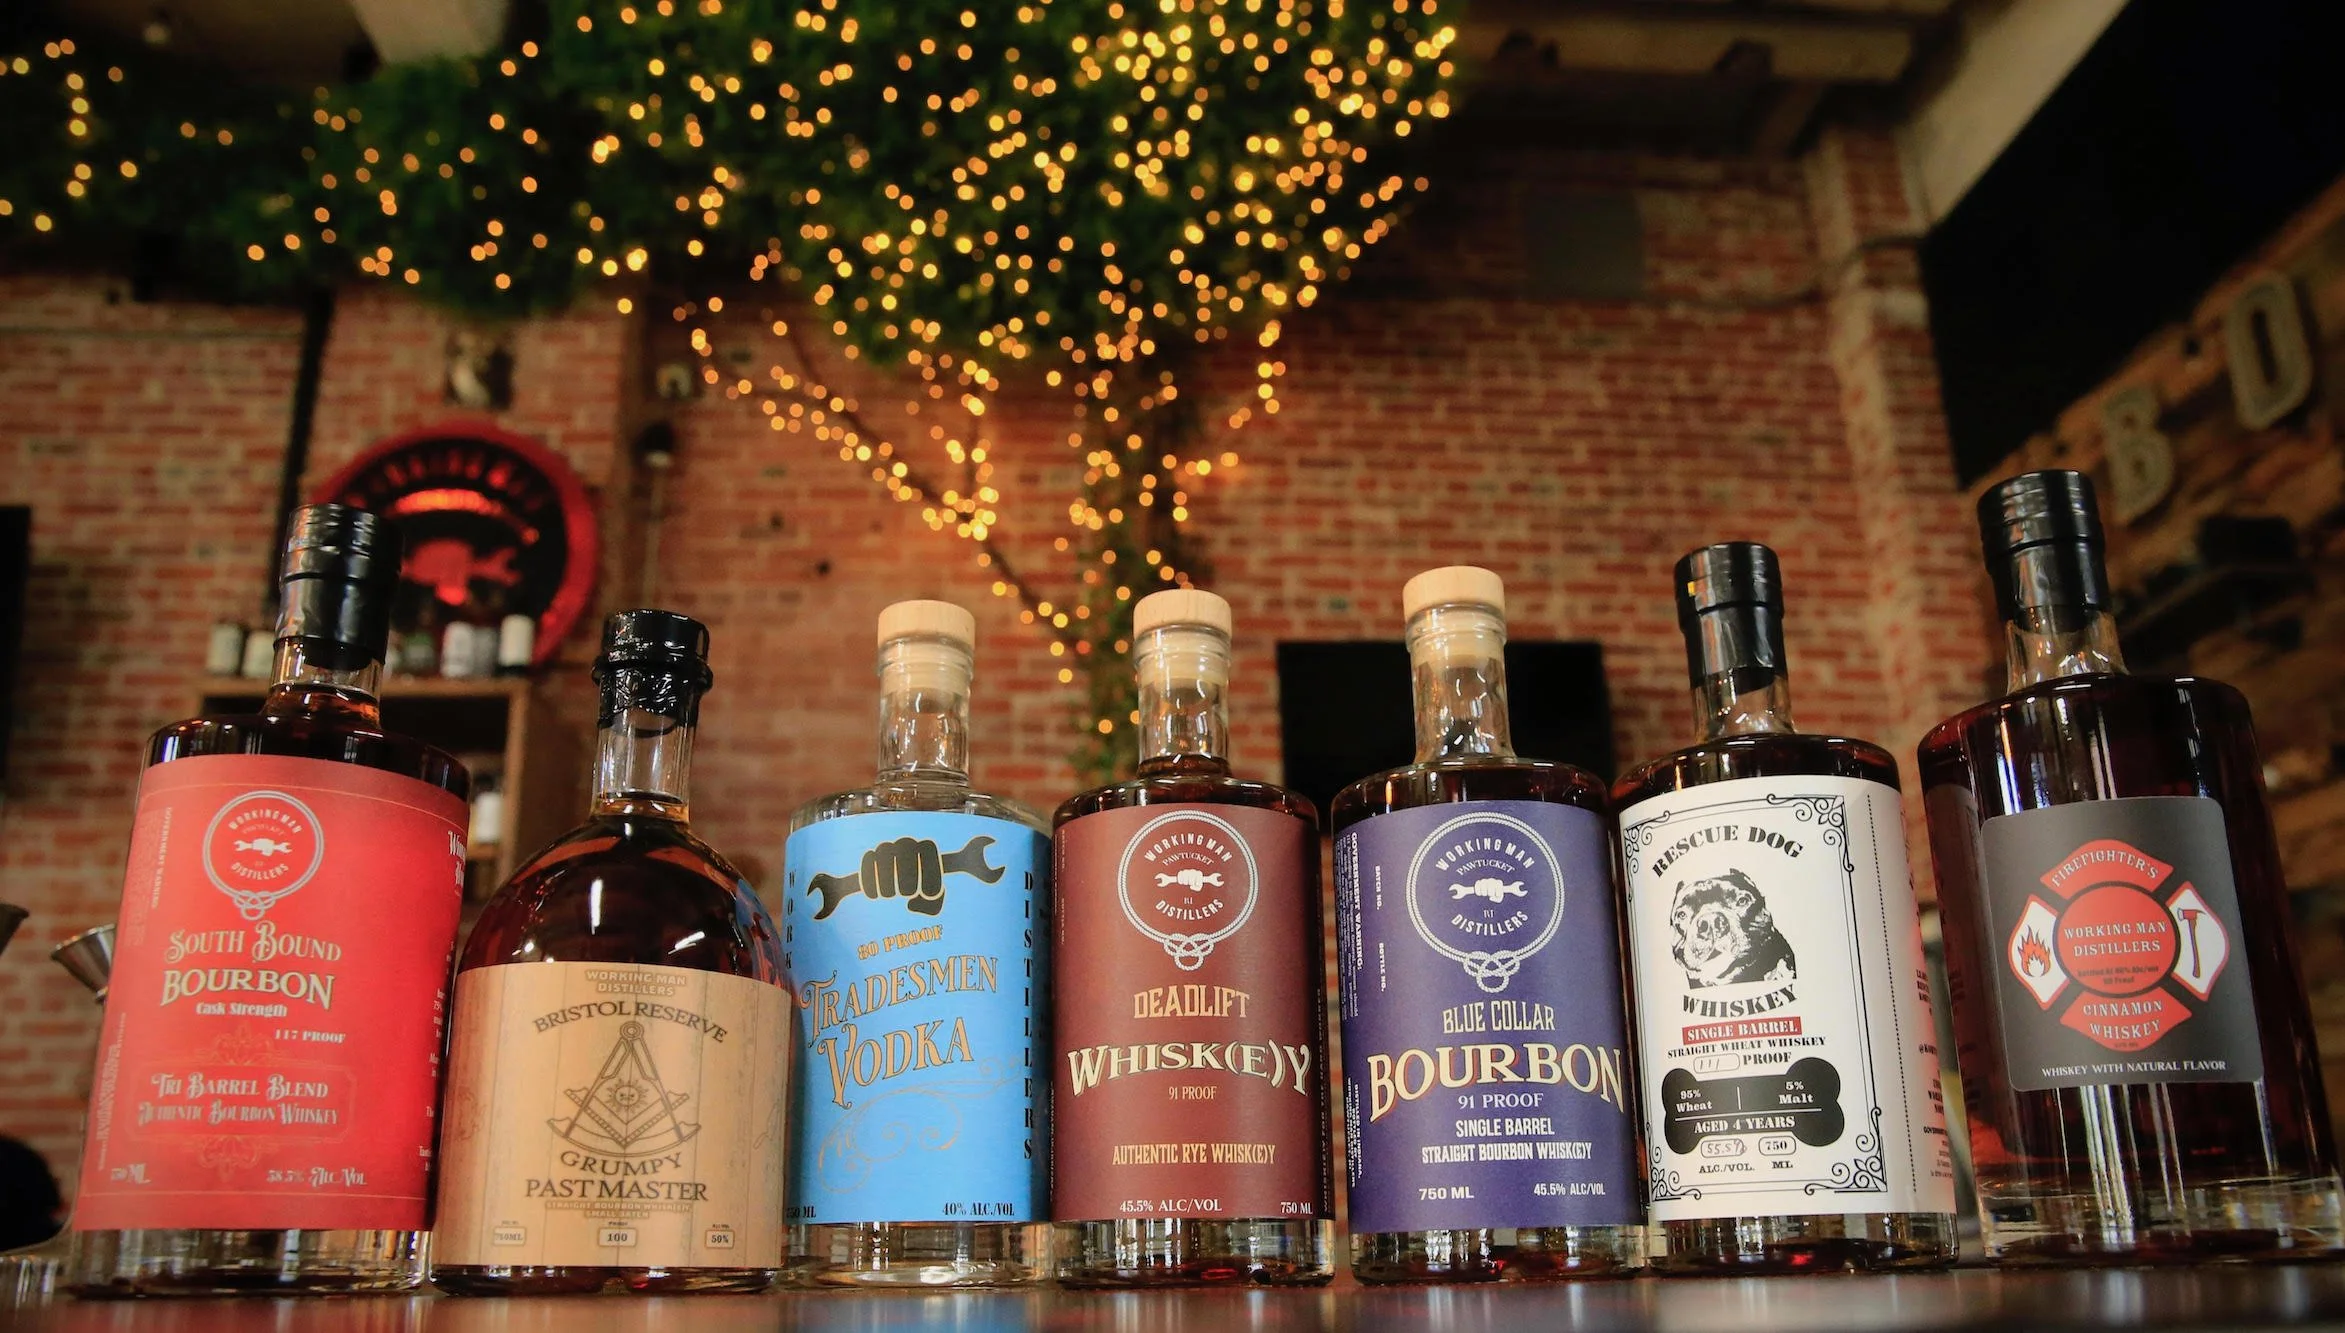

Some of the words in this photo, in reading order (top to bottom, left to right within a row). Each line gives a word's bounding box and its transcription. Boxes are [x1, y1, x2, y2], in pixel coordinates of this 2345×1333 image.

[1144, 833, 1204, 862] WORKING
[1206, 841, 1233, 863] MAN
[1436, 838, 1502, 872] WORKING
[1504, 843, 1535, 869] MAN
[1652, 825, 1739, 878] RESCUE
[1747, 826, 1804, 859] DOG
[1162, 852, 1215, 867] PAWTUCKET
[1456, 859, 1516, 876] PAWTUCKET
[2052, 849, 2159, 888] FIREFIGHTER'S
[231, 861, 288, 881] DISTILLERS
[1351, 831, 1361, 910] GOVERNMENT
[1374, 865, 1382, 892] BATCH
[1155, 898, 1225, 922] DISTILLERS
[1483, 909, 1495, 918] RI
[1451, 910, 1529, 936] DISTILLERS
[2064, 922, 2133, 940] WORKING
[2136, 920, 2168, 935] MAN
[856, 941, 880, 961] 80
[882, 923, 943, 953] PROOF
[1354, 912, 1363, 971] WARNING:
[2073, 939, 2162, 958] DISTILLERS
[1379, 942, 1387, 975] BOTTLE
[585, 970, 653, 984] WORKING
[655, 974, 688, 986] MAN
[160, 968, 336, 1010] BOURBON
[597, 983, 676, 997] DISTILLERS
[195, 1001, 226, 1016] Cask
[229, 1002, 288, 1018] Strength
[799, 953, 1000, 1049] TRADESMEN
[1133, 984, 1250, 1019] DEADLIFT
[1682, 984, 1798, 1019] WHISKEY
[2083, 1000, 2164, 1017] CINNAMON
[533, 1001, 632, 1034] BRISTOL
[634, 1002, 729, 1044] RESERVE
[1023, 869, 1034, 1161] DISTILLERS
[1443, 1003, 1486, 1034] BLUE
[1491, 1000, 1556, 1032] COLLAR
[274, 1029, 299, 1040] 117
[301, 1030, 347, 1043] PROOF
[1687, 1024, 1734, 1042] SINGLE
[1738, 1019, 1798, 1037] BARREL
[2089, 1020, 2162, 1040] WHISKEY
[1667, 1043, 1718, 1059] STRAIGHT
[1720, 1039, 1763, 1053] WHEAT
[1767, 1036, 1827, 1049] WHISKEY
[816, 1016, 976, 1111] VODKA
[1067, 1039, 1313, 1097] WHISK(E)Y
[1743, 1052, 1793, 1066] PROOF
[2041, 1064, 2089, 1078] WHISKEY
[2091, 1063, 2125, 1075] WITH
[2127, 1061, 2181, 1073] NATURAL
[2182, 1060, 2228, 1073] FLAVOR
[1168, 1086, 1179, 1100] 91
[1181, 1086, 1218, 1101] PROOF
[1367, 1043, 1625, 1125] BOURBON
[1785, 1081, 1805, 1092] 5%
[1458, 1095, 1476, 1109] 91
[1481, 1093, 1544, 1109] PROOF
[1680, 1089, 1702, 1101] 95%
[1778, 1093, 1814, 1105] Malt
[1675, 1100, 1713, 1113] Wheat
[1455, 1119, 1503, 1138] SINGLE
[1504, 1117, 1555, 1137] BARREL
[1693, 1120, 1729, 1134] AGED
[1733, 1120, 1742, 1131] 4
[1747, 1115, 1797, 1129] YEARS
[1112, 1144, 1179, 1166] AUTHENTIC
[1181, 1144, 1208, 1165] RYE
[1210, 1144, 1276, 1165] WHISK(E)Y
[1422, 1144, 1476, 1164] STRAIGHT
[1478, 1143, 1534, 1162] BOURBON
[1537, 1142, 1593, 1161] WHISK(E)Y
[1765, 1140, 1788, 1150] 750
[560, 1150, 683, 1177] GRUMPY
[1698, 1162, 1755, 1174] ALC./VOL.
[1771, 1160, 1794, 1170] ML
[525, 1179, 596, 1199] PAST
[598, 1179, 709, 1201] MASTER
[1418, 1187, 1448, 1200] 750
[1450, 1186, 1475, 1200] ML
[1533, 1183, 1567, 1197] 45.5%
[1569, 1182, 1606, 1196] ALC/VOL
[546, 1202, 592, 1210] STRAIGHT
[594, 1202, 642, 1210] BOURBON
[802, 1204, 817, 1218] ML
[942, 1202, 967, 1216] 40%
[970, 1202, 1016, 1217] ALC./VOL
[1119, 1200, 1154, 1213] 45.5%
[1158, 1199, 1223, 1213] ALC/VOL
[1280, 1201, 1299, 1215] 750
[1300, 1203, 1314, 1215] ML
[606, 1232, 628, 1243] 100
[711, 1234, 729, 1243] 50%
